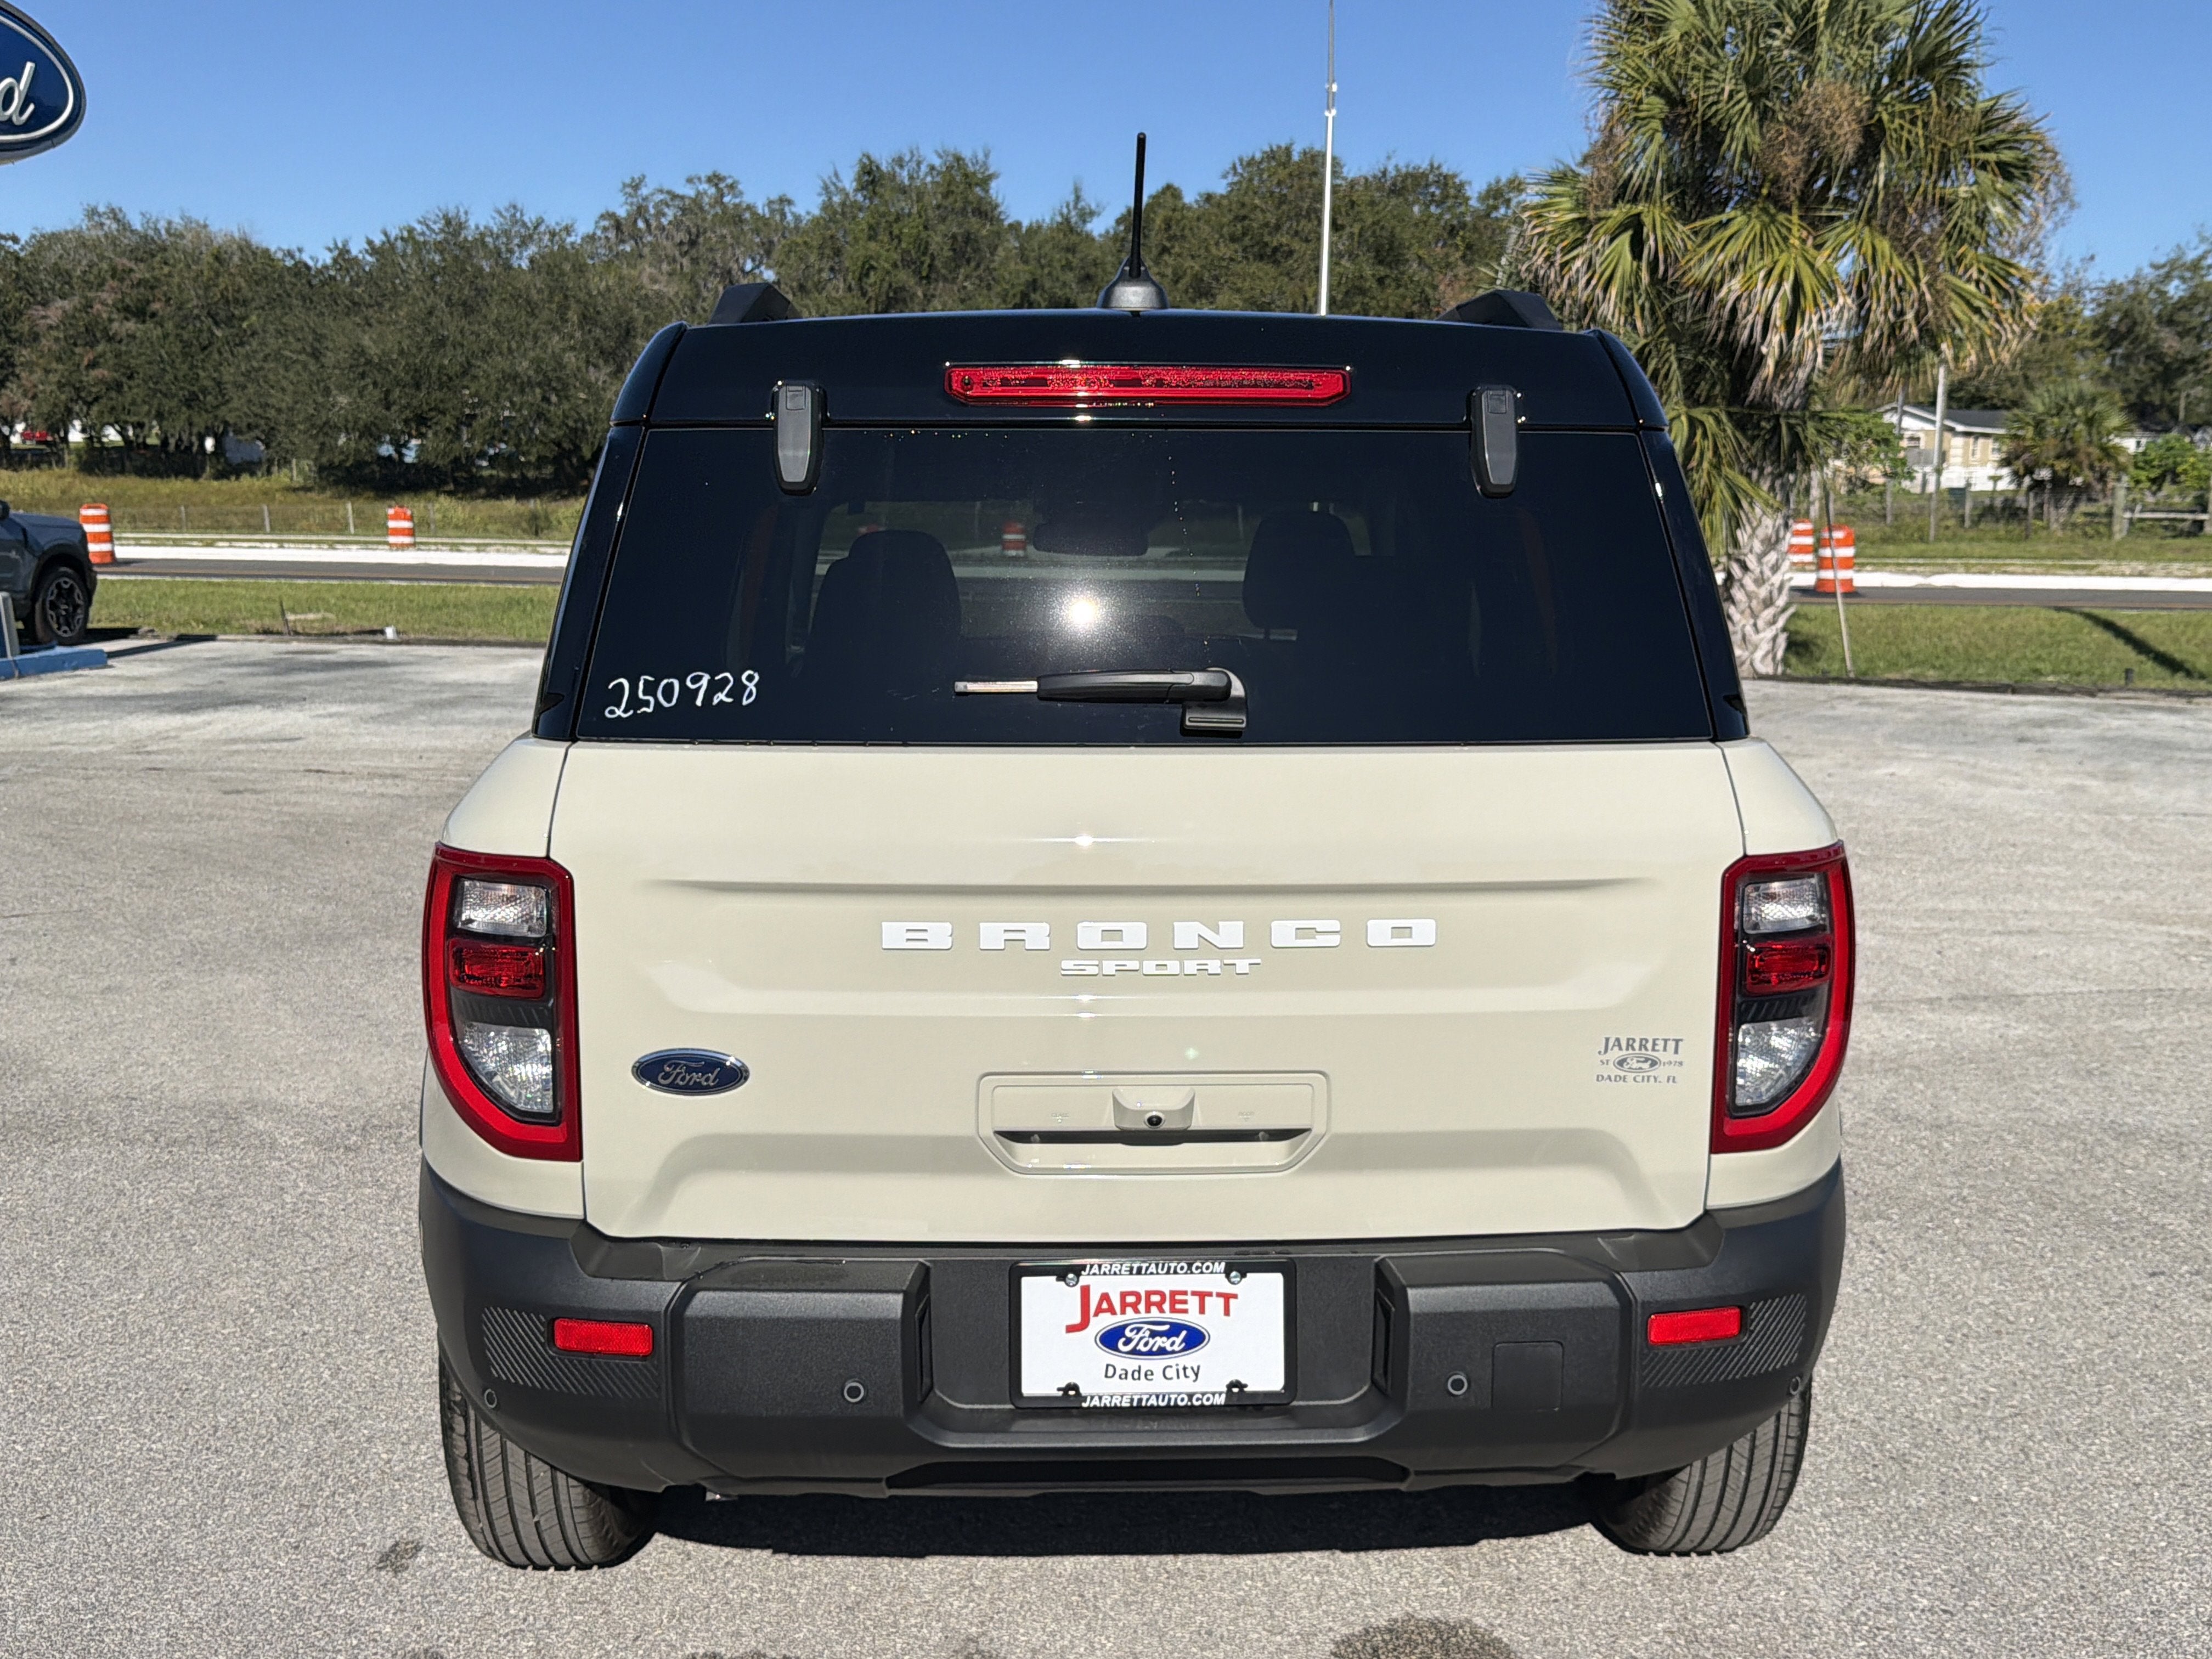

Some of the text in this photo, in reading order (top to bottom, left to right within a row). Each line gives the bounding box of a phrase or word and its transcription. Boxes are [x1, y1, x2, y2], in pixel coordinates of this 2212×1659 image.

[605, 670, 760, 718] 250928
[881, 918, 1436, 950] BRONCO
[1060, 958, 1261, 976] SPORT
[1598, 1037, 1684, 1055] JARRETT
[658, 1060, 720, 1086] Ford
[1596, 1074, 1628, 1082] DADE
[1081, 1262, 1226, 1276] JARRETTAUTO.COM
[1065, 1284, 1238, 1334] JARRETT
[1118, 1324, 1187, 1352] Ford
[1104, 1364, 1201, 1382] Dade City
[1081, 1393, 1226, 1408] JARRETTAUTO.COM
